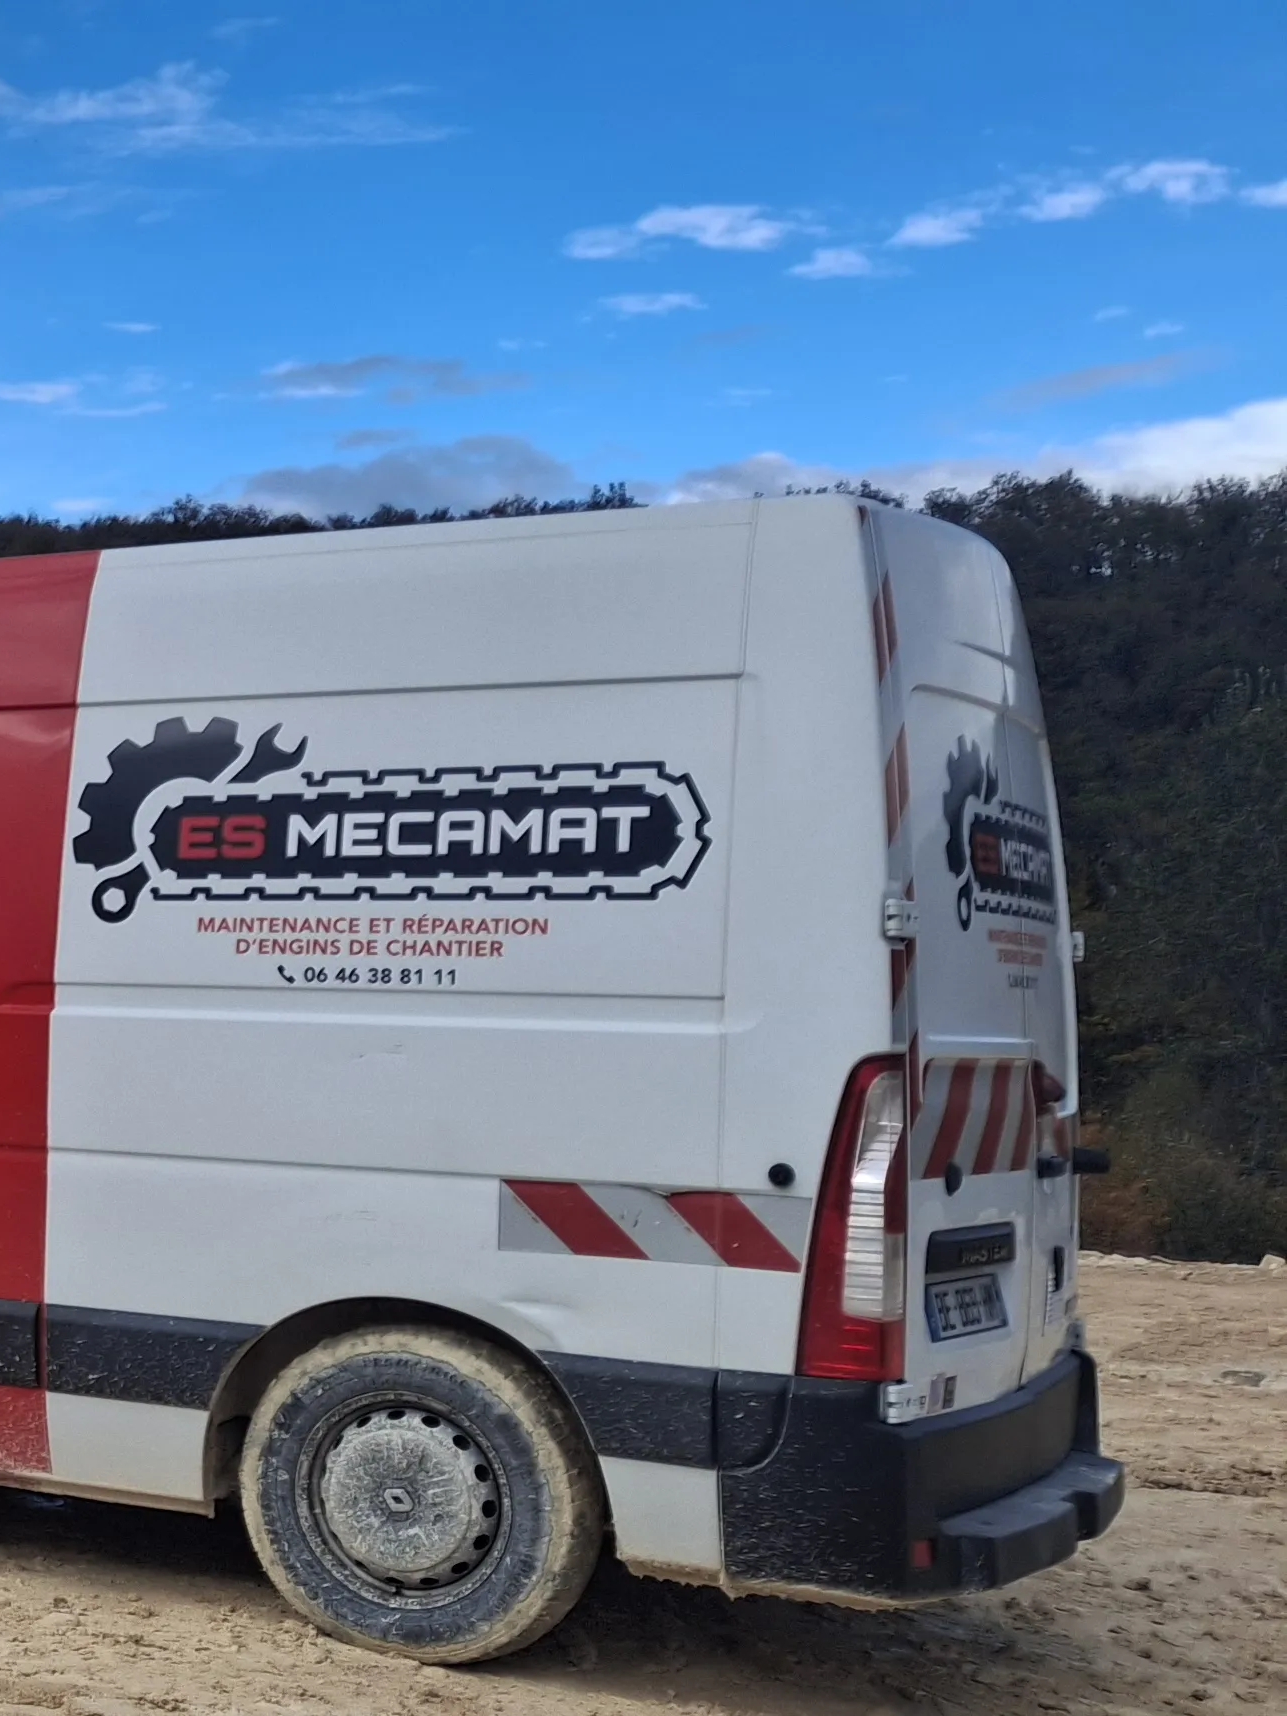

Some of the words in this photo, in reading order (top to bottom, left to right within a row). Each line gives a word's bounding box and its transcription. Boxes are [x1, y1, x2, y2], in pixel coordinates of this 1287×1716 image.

[177, 815, 267, 860] ES
[286, 806, 651, 859] MECAMAT
[197, 916, 361, 935] MAINTENANCE
[368, 916, 395, 935] ET
[402, 912, 549, 936] RÉPARATION
[235, 937, 342, 957] D'ENGINS
[350, 938, 378, 957] DE
[386, 938, 503, 959] CHANTIER
[304, 967, 328, 984] 06
[336, 967, 360, 984] 46
[368, 967, 392, 984] 38
[400, 967, 423, 984] 81
[433, 968, 457, 985] 11
